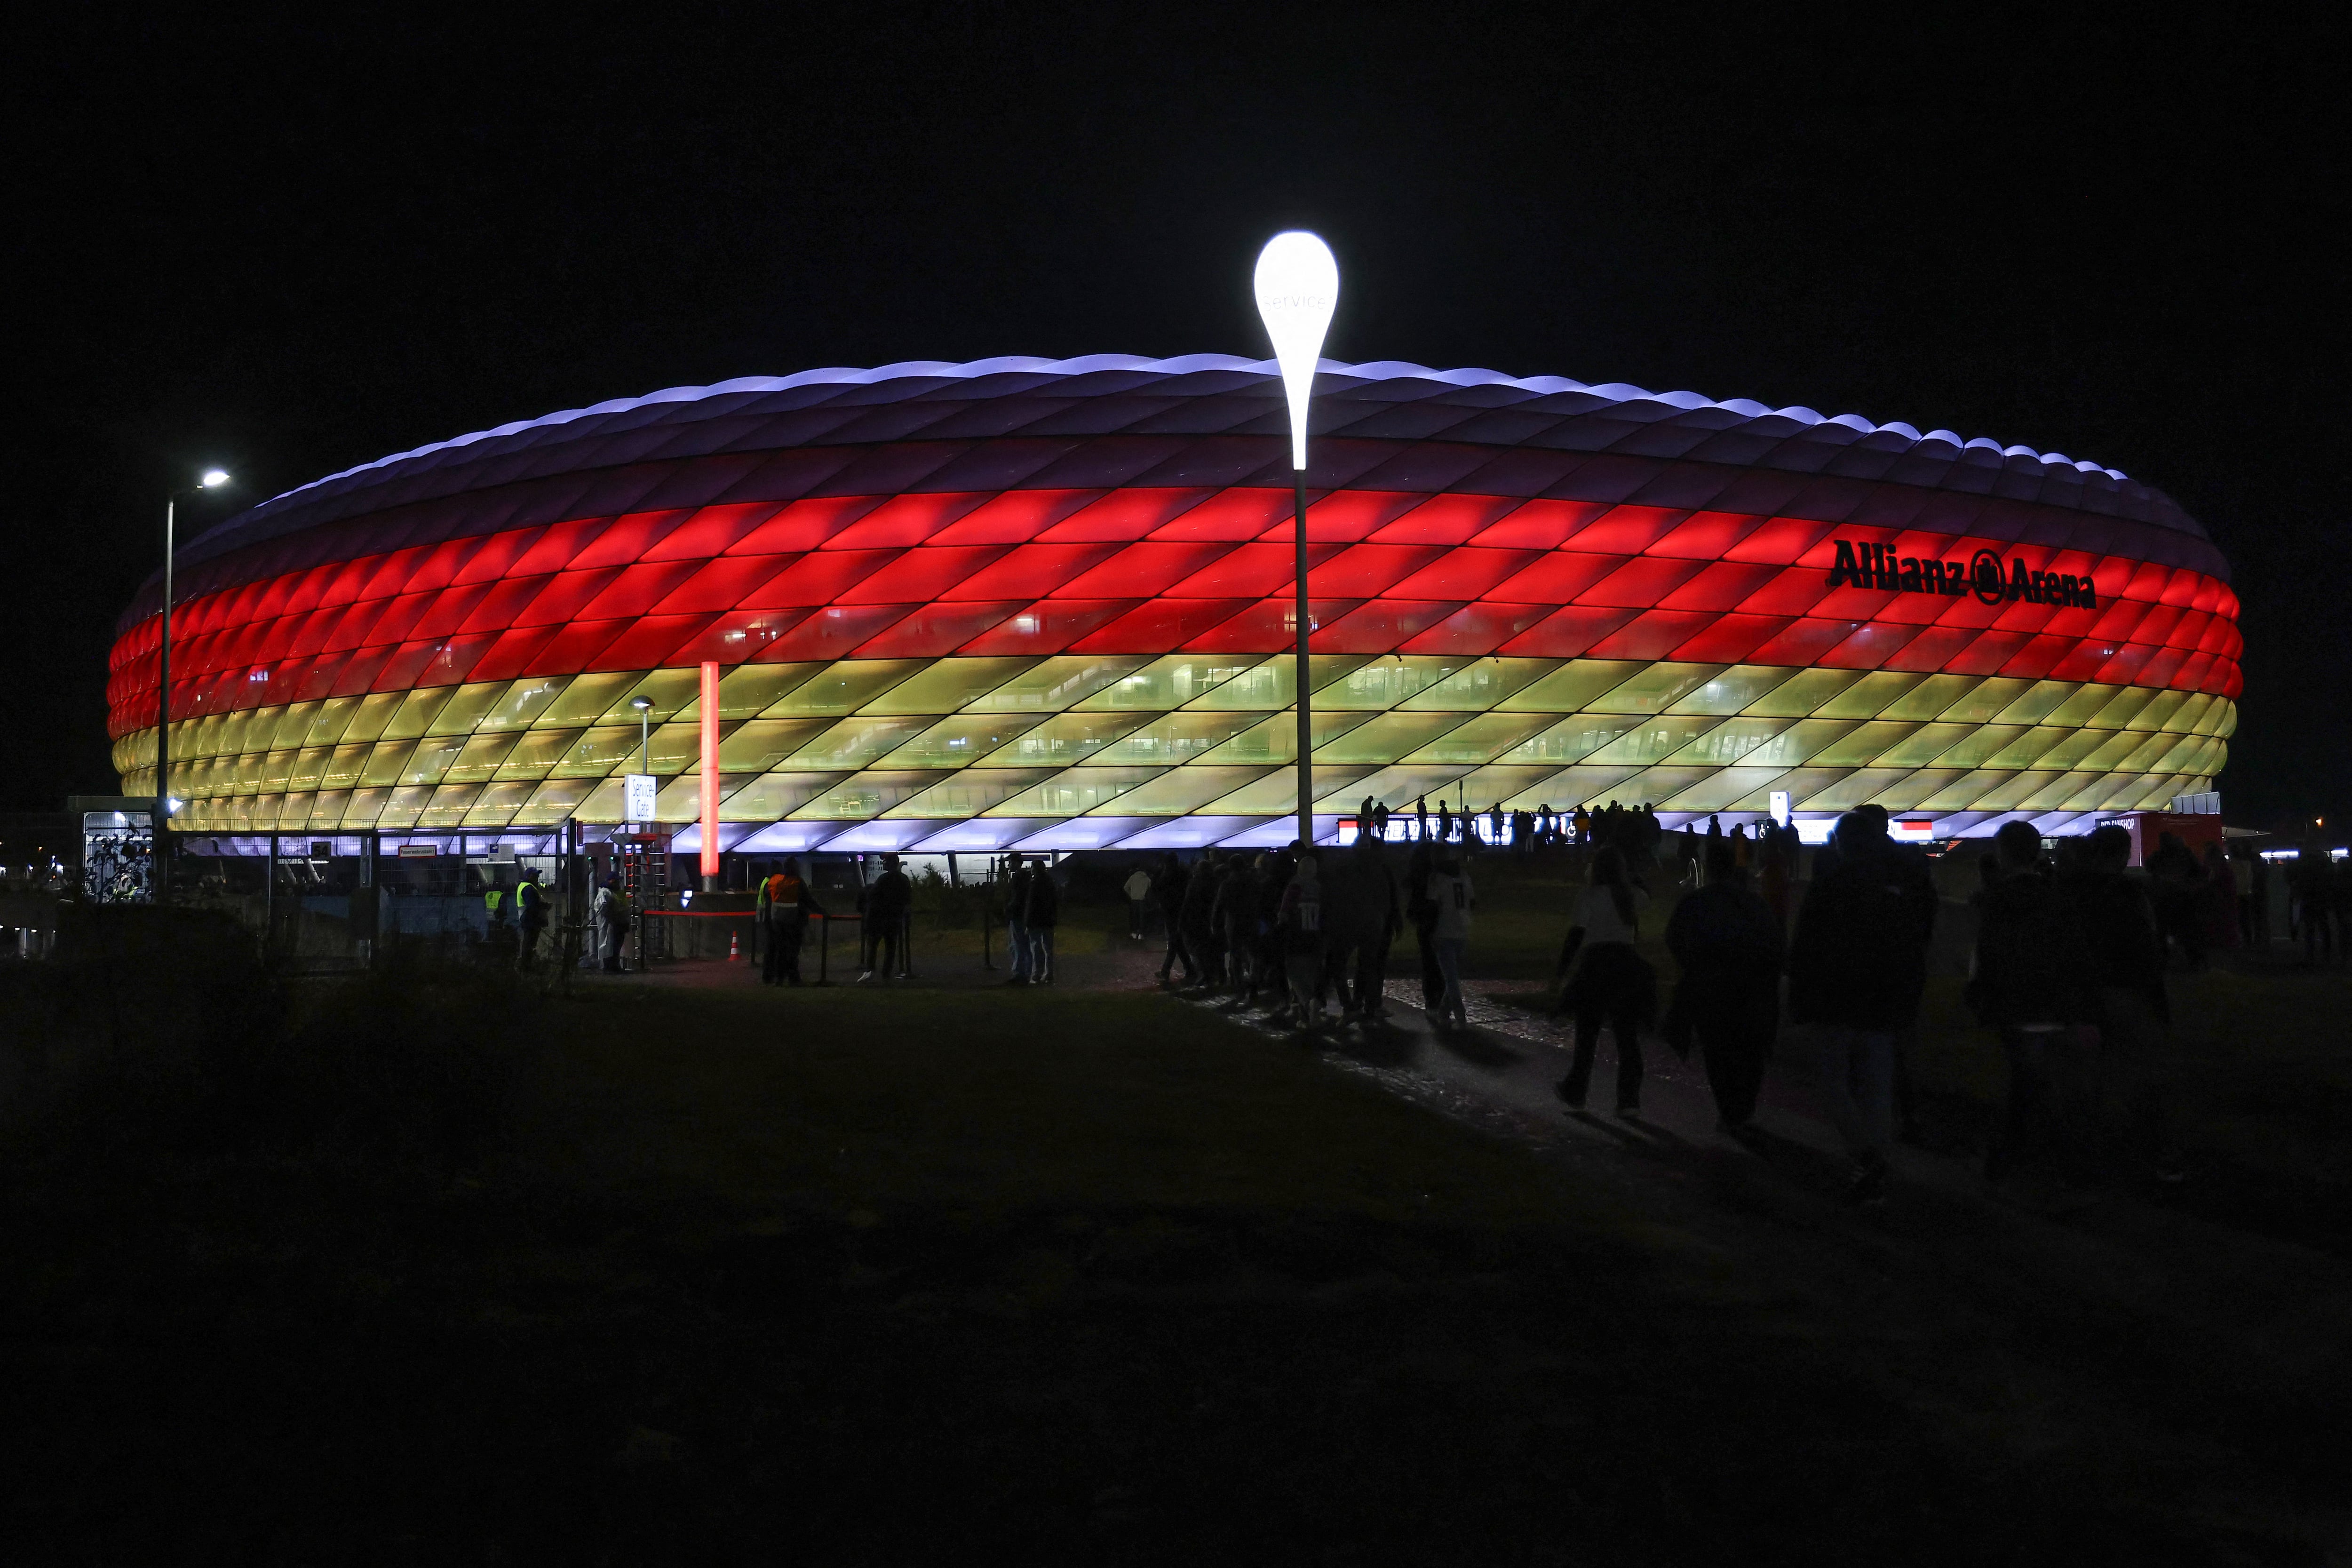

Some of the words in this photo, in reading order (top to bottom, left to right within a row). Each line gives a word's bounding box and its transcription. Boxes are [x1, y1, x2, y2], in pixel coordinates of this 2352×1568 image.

[1830, 540, 1968, 597] Allianz
[2007, 557, 2097, 610] Arena
[633, 779, 654, 797] Service-
[636, 799, 649, 817] Gate
[2111, 818, 2135, 830] FANSHOP
[314, 845, 328, 857] 54
